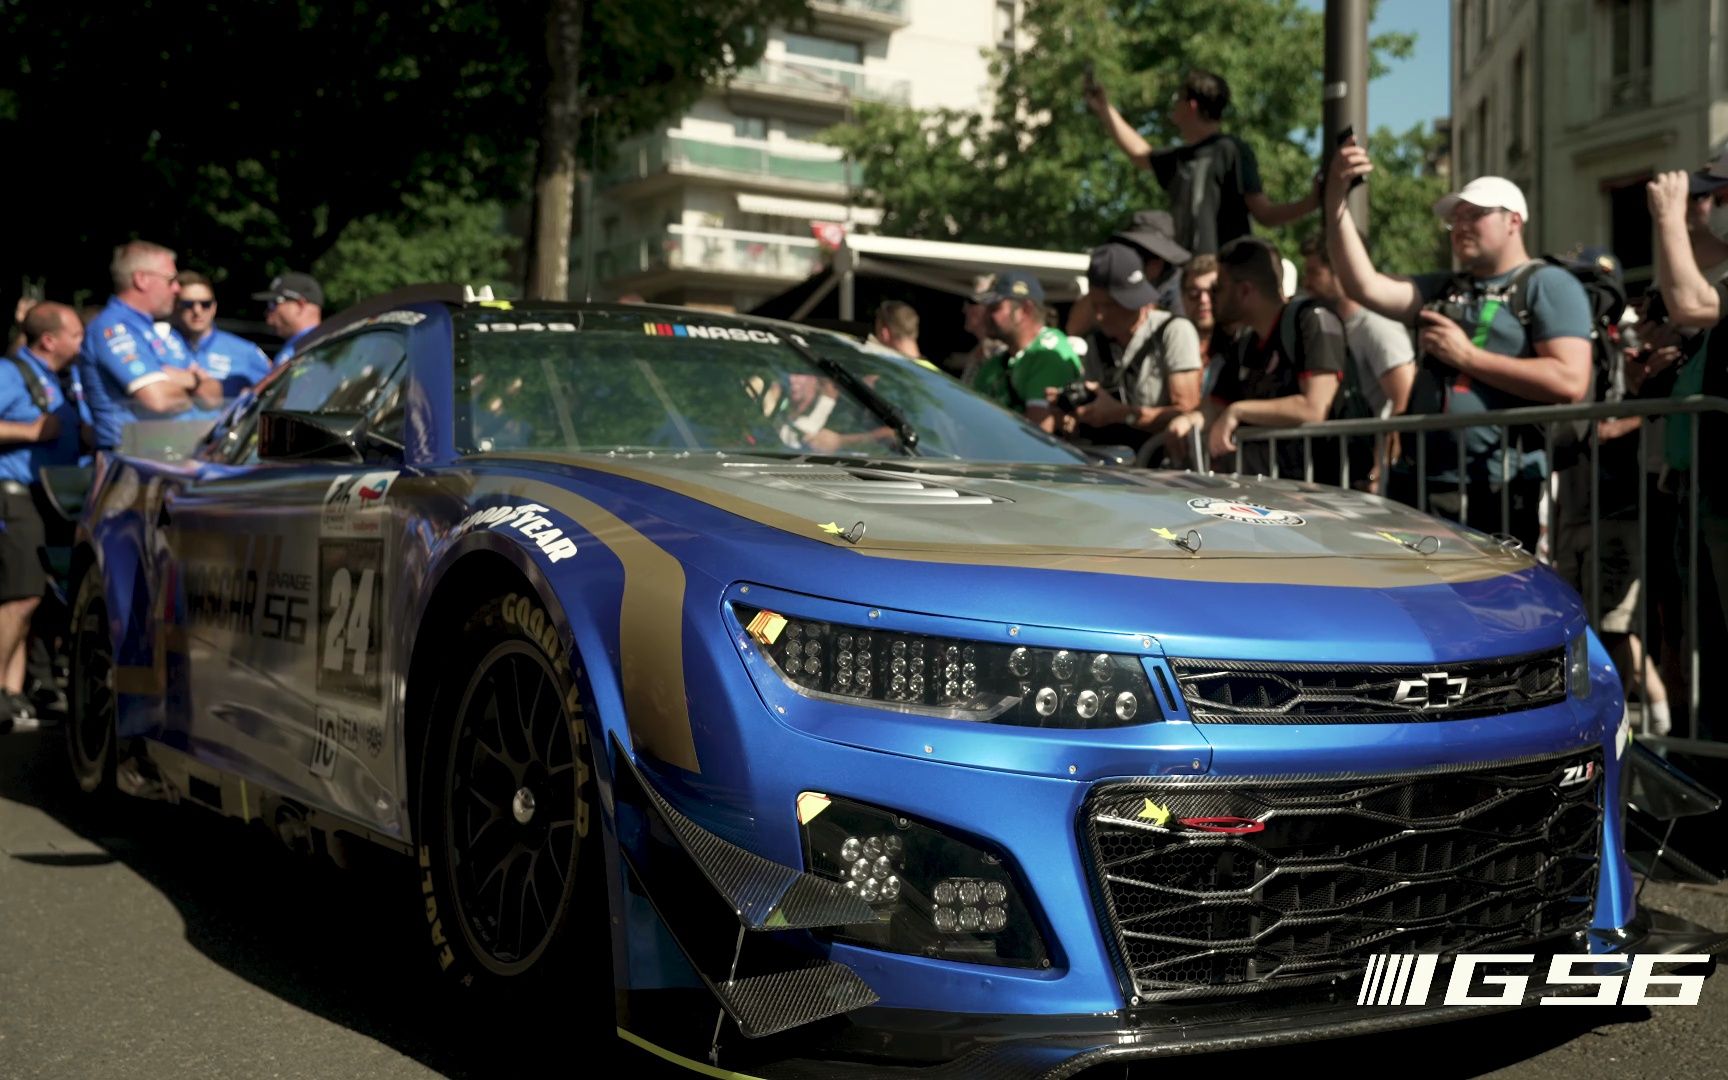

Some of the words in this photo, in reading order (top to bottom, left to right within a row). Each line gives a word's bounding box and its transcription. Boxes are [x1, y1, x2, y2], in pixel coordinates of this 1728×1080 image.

[261, 592, 309, 645] 56
[322, 567, 375, 676] 24
[417, 844, 455, 972] EAGLE
